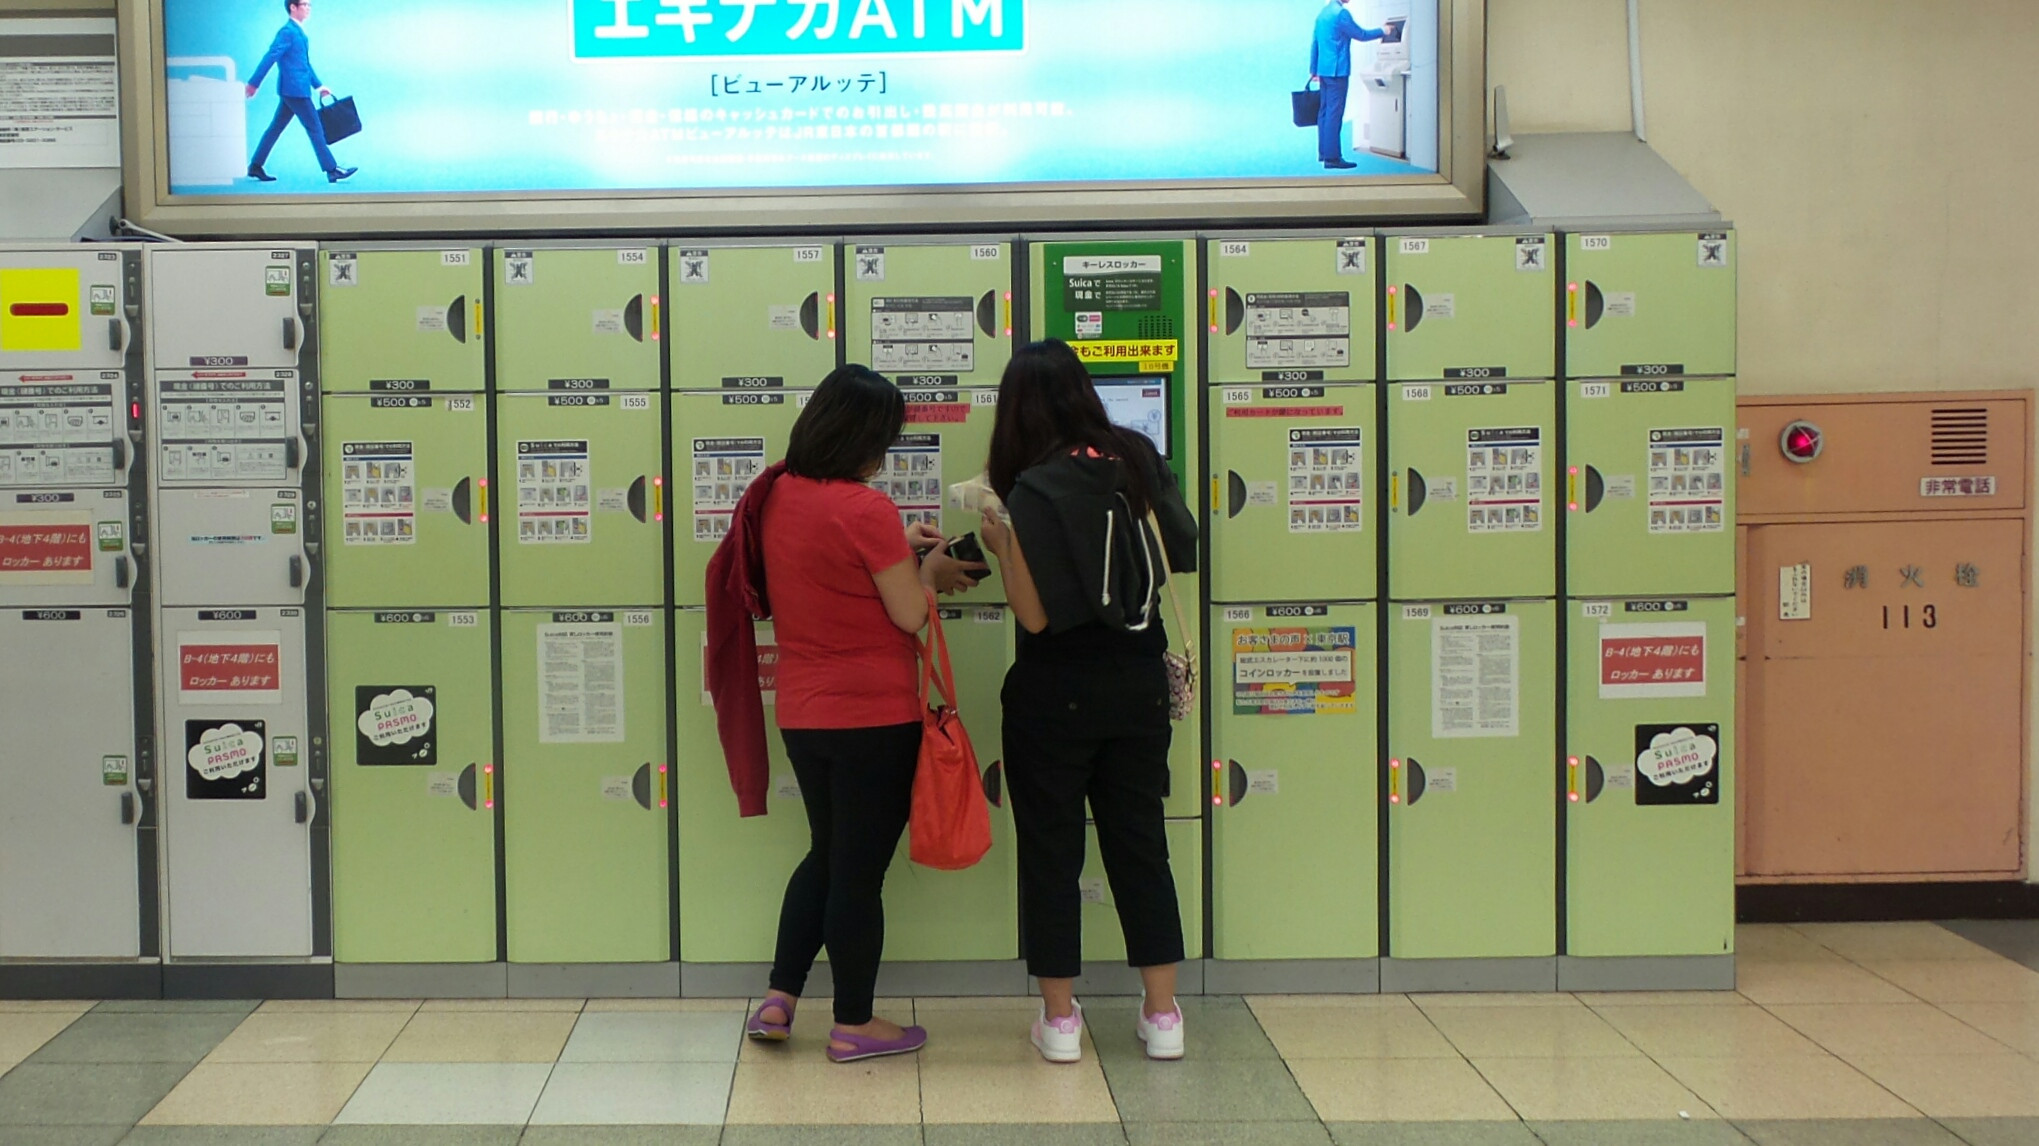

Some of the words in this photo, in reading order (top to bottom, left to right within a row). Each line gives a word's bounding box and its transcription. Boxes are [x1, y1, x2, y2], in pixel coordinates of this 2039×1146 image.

[711, 71, 886, 96] [ビューアルッテ]
[1404, 242, 1426, 250] 1567
[1585, 238, 1607, 246] 1570
[974, 248, 997, 257] 1560
[1224, 245, 1246, 254] 1564
[444, 254, 466, 262] 1551
[621, 252, 644, 261] 1554
[797, 250, 819, 259] 1557
[1082, 261, 1146, 269] キーレスロッカー
[205, 357, 233, 365] ¥300
[1637, 366, 1667, 374] ¥300
[1278, 372, 1307, 380] ¥300
[386, 381, 414, 389] ¥300
[565, 380, 592, 388] ¥300
[738, 378, 766, 386] ¥300
[1627, 382, 1656, 391] ¥500
[1269, 389, 1297, 397] ¥500
[1406, 390, 1428, 398] 1568
[1451, 385, 1479, 394] ¥500
[1585, 386, 1607, 394] 1571
[728, 395, 757, 404] ¥500
[903, 393, 931, 401] ¥500
[976, 395, 996, 403] 1561
[1227, 392, 1249, 400] 1565
[377, 398, 405, 406] ¥500
[450, 400, 471, 409] 1552
[624, 398, 646, 407] 1555
[1925, 478, 1991, 495] 非常電話
[31, 494, 60, 502] ¥300
[2, 556, 40, 566] ロッカー
[43, 556, 84, 567] あります
[1844, 562, 1980, 589] 消火栓
[1227, 610, 1249, 618] 1566
[1272, 607, 1300, 615] ¥600
[1406, 608, 1428, 616] 1569
[1450, 605, 1478, 614] ¥600
[1585, 606, 1608, 614] 1572
[213, 611, 242, 620] ¥600
[380, 613, 408, 622] ¥600
[452, 614, 474, 623] 1553
[559, 613, 587, 622] ¥600
[627, 614, 649, 623] 1556
[978, 612, 1000, 620] 1562
[1883, 604, 1936, 629] 113
[1238, 633, 1300, 645] お客さまの声
[1610, 669, 1650, 680] ロッカー
[1652, 668, 1695, 680] あります
[189, 676, 227, 686] ロッカー
[230, 676, 271, 686] あります
[374, 705, 414, 720] Suica
[377, 714, 417, 731] PASMO
[204, 738, 244, 754] Suica
[1654, 743, 1696, 760] Suica
[207, 748, 247, 766] PASMO
[1657, 752, 1700, 770] PASMO
